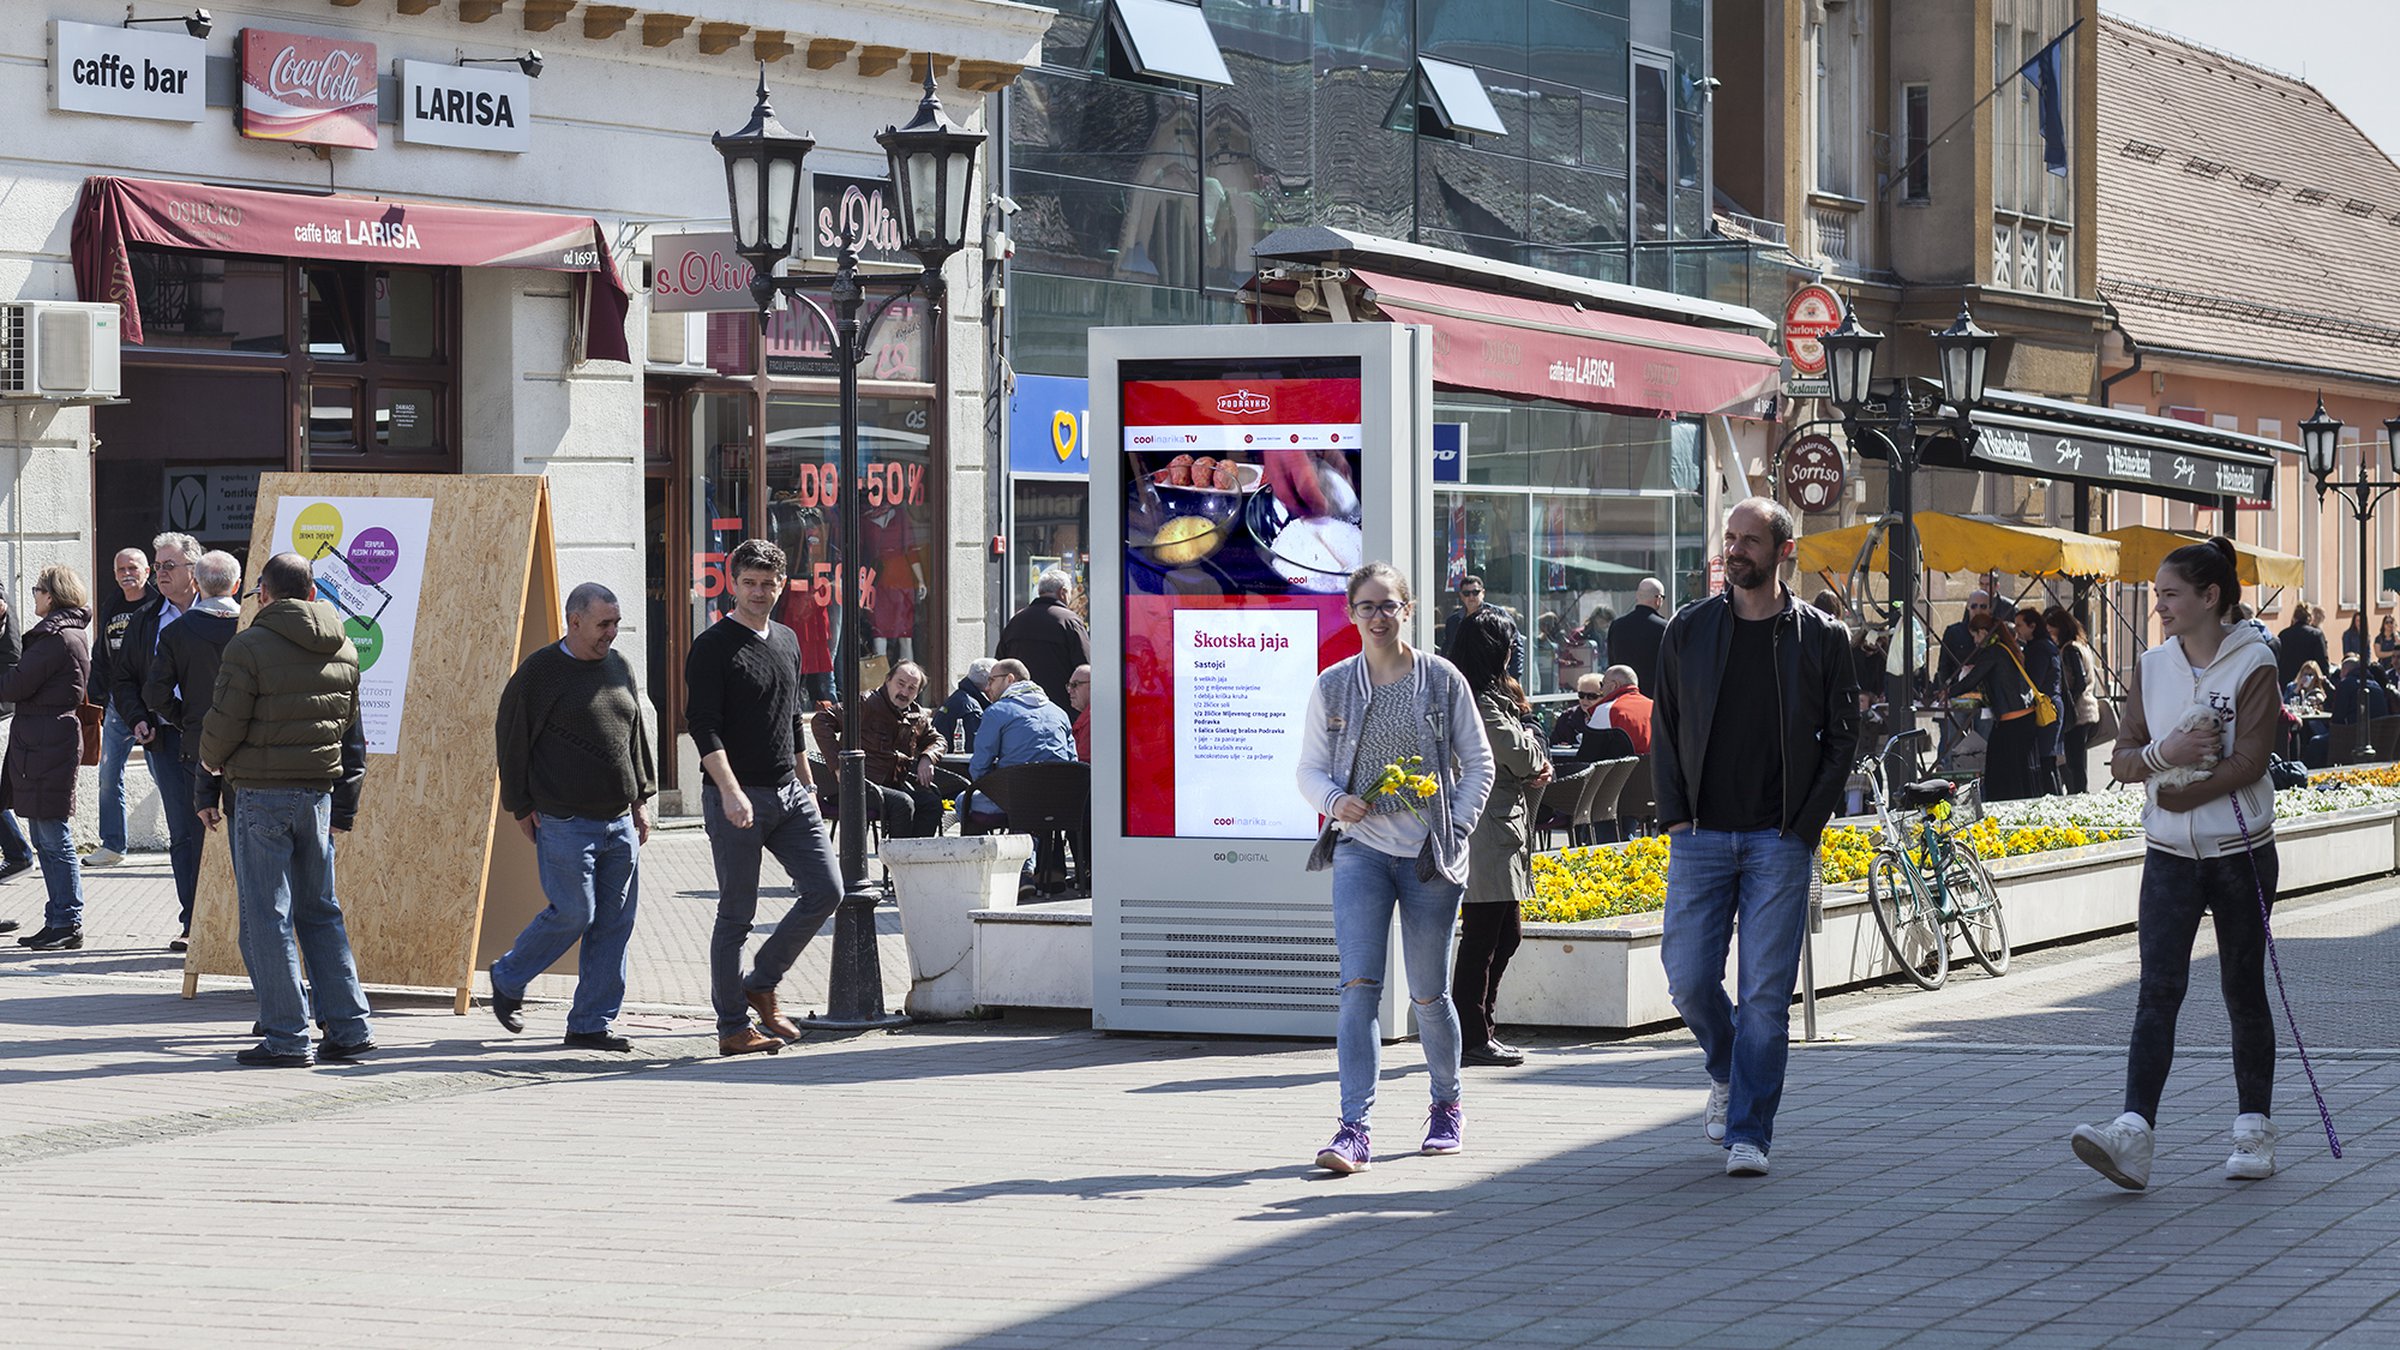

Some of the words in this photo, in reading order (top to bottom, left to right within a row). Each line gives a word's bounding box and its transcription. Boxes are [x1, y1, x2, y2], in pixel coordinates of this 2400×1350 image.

[73, 53, 135, 91] caffe
[143, 57, 188, 95] bar
[415, 85, 515, 129] LARISA
[294, 223, 322, 243] caffe
[323, 226, 342, 245] bar
[345, 220, 420, 250] LARISA
[563, 250, 573, 265] od
[575, 251, 601, 265] 1697.
[1549, 361, 1565, 381] caffe
[1576, 356, 1616, 388] LARISA
[1220, 398, 1267, 409] PODRAVKA
[1788, 462, 1840, 484] Sorriso
[1986, 429, 2034, 463] Heineken
[2055, 439, 2083, 471] Sky
[2114, 446, 2152, 479] Heineken
[2173, 456, 2196, 485] Sky
[2223, 464, 2255, 494] Heineken
[800, 463, 839, 508] DO
[1194, 630, 1256, 648] Škotska
[1260, 633, 1289, 652] jaja
[1194, 660, 1226, 670] Sastojci
[1213, 852, 1226, 861] GO
[1238, 853, 1270, 862] DIGITAL
